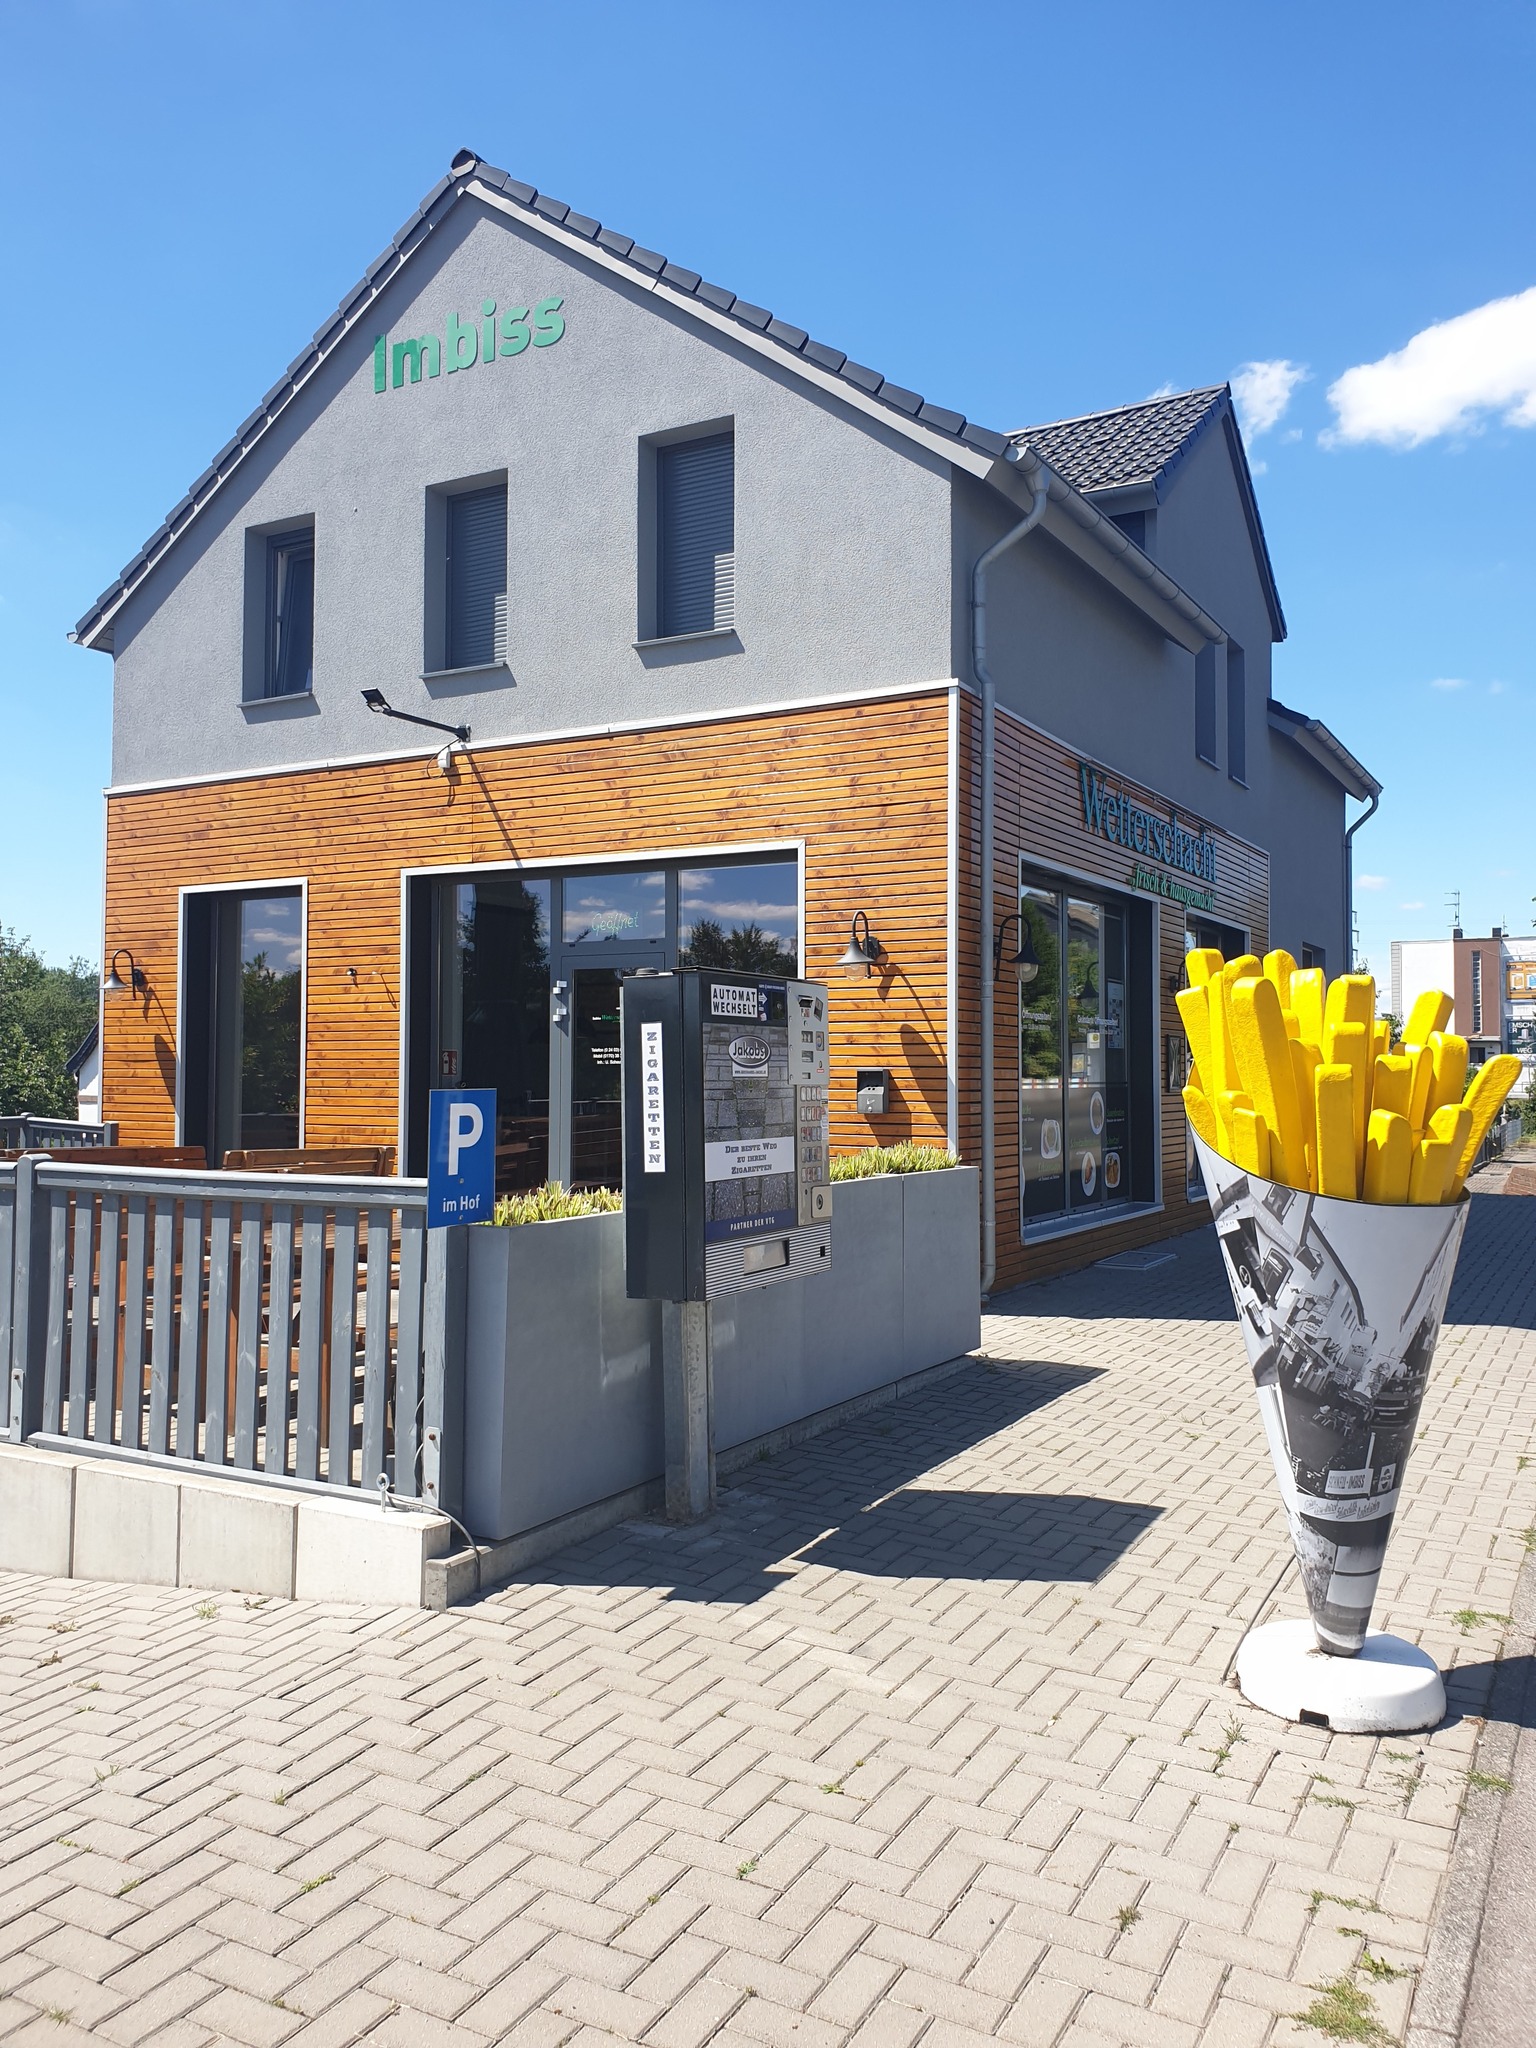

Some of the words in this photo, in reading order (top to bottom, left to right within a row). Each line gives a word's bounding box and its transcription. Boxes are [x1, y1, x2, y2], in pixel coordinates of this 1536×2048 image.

[373, 296, 565, 394] Imbiss
[1079, 761, 1218, 884] Wetterschacht
[1160, 872, 1168, 897] &
[591, 910, 639, 937] Geöffnet
[712, 988, 756, 1002] AUTOMAT
[713, 1001, 756, 1015] WECHSELT
[732, 1042, 766, 1060] Jakobs
[646, 1031, 661, 1164] ZIGARETTEN
[448, 1102, 484, 1176] P
[443, 1198, 457, 1213] im
[460, 1194, 480, 1211] Hof
[730, 1220, 753, 1231] PARTNER
[754, 1218, 764, 1227] DER
